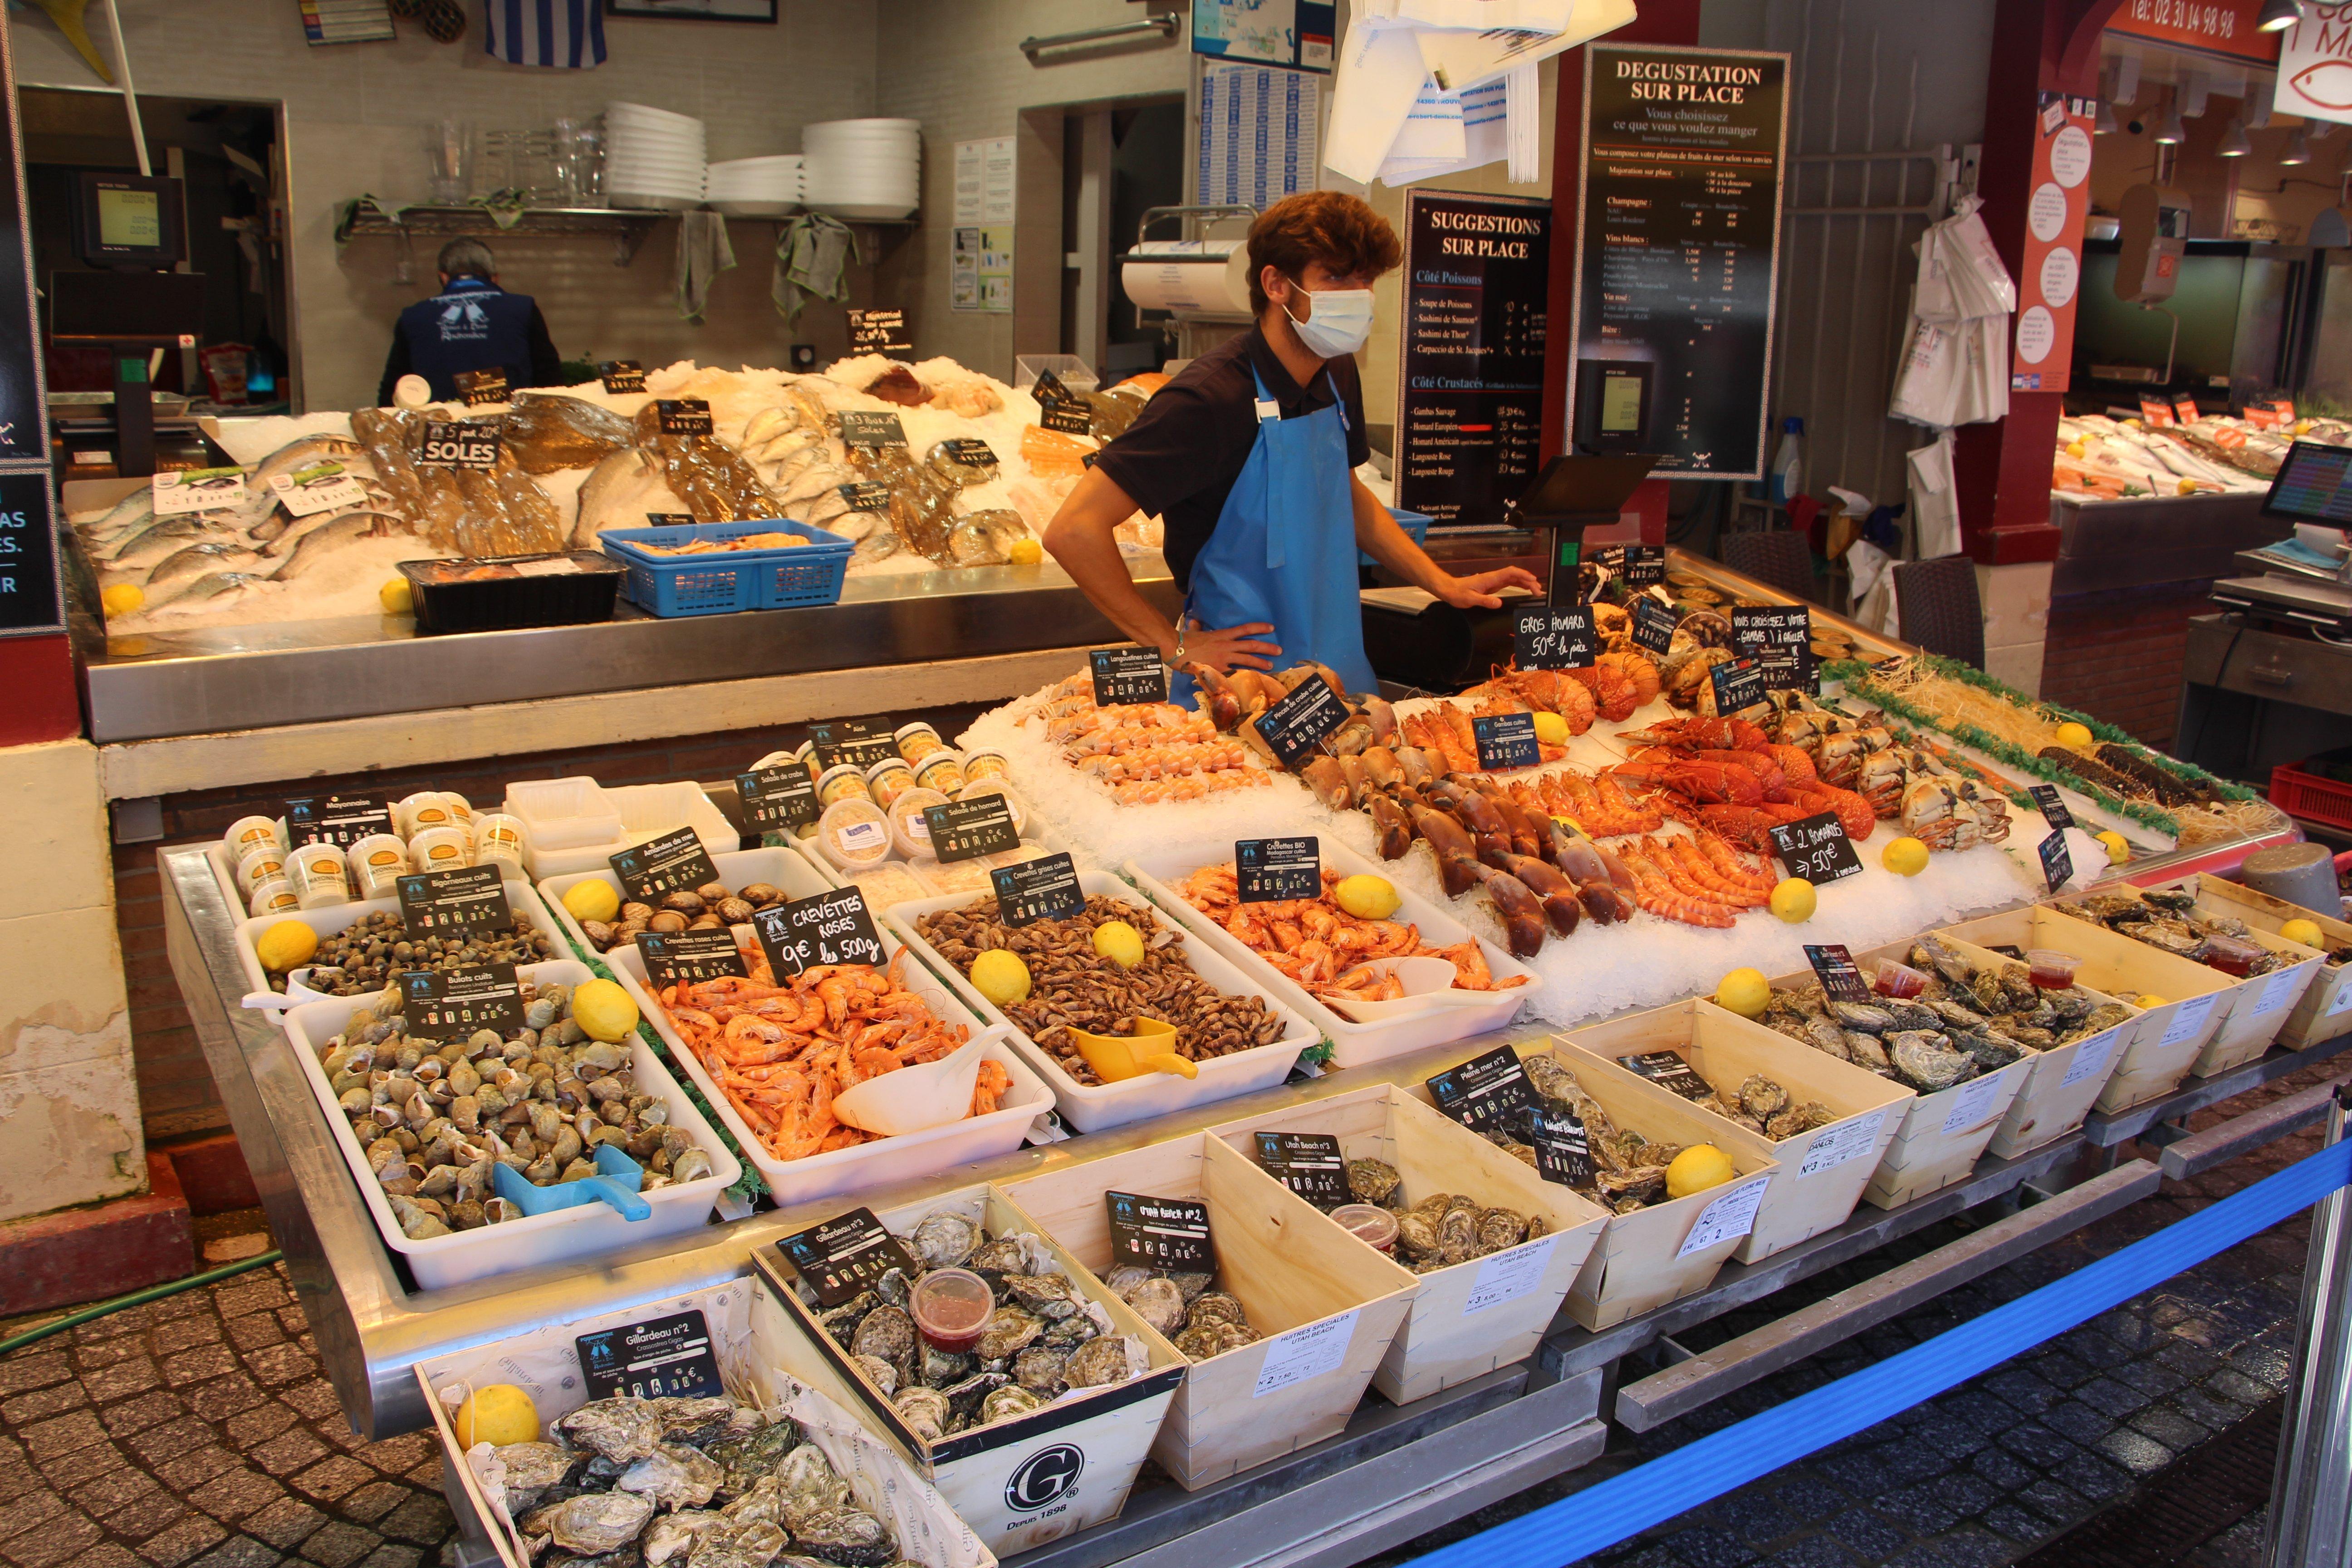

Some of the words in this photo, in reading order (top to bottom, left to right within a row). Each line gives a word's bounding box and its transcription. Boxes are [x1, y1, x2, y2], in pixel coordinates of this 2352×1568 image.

[2155, 0, 2170, 25] 02
[2173, 2, 2184, 28] 31
[2187, 5, 2199, 31] 14
[2203, 6, 2217, 35] 98
[2220, 9, 2234, 39] 98
[1617, 61, 1761, 85] DEGUSTATION
[1631, 82, 1671, 100] SUR
[1677, 85, 1744, 104] PLACE
[1646, 108, 1671, 119] Vous
[1675, 109, 1728, 122] choisissez
[1613, 120, 1626, 129] ce
[1629, 121, 1648, 132] que
[1651, 123, 1676, 132] vous
[1680, 123, 1714, 134] voulez
[1718, 126, 1758, 138] manger
[1594, 147, 1608, 156] Vous
[1609, 149, 1639, 158] composez
[1656, 151, 1677, 161] plateau
[1688, 152, 1703, 161] fruits
[1609, 166, 1643, 175] Majoration
[1656, 168, 1672, 176] place
[1607, 196, 1647, 206] Champagne
[1431, 211, 1541, 235] SUGGESTIONS
[1623, 235, 1644, 243] blancs
[1442, 237, 1474, 255] SUR
[1478, 240, 1528, 259] PLACE
[1416, 270, 1439, 283] Côté
[1442, 272, 1481, 284] Poissons
[1419, 298, 1437, 309] Soupe
[1448, 300, 1472, 309] Poissons
[1412, 376, 1435, 388] Côté
[1437, 377, 1483, 389] Crustacés
[1414, 407, 1434, 416] Gambas
[1436, 408, 1456, 417] Sauvage
[1413, 422, 1433, 431] Homard
[1435, 422, 1458, 432] Européen
[1413, 438, 1432, 446] Homard
[1434, 437, 1459, 446] Américain
[426, 441, 495, 462] SOLES
[1412, 453, 1437, 462] Langouste
[1412, 467, 1436, 477] Langouste
[1439, 467, 1454, 477] Rouge
[1521, 616, 1545, 633] GROS
[1552, 614, 1585, 631] HOMARD
[1734, 615, 1749, 627] VOUS
[1751, 614, 1786, 627] CHOISISSEZ
[1787, 614, 1807, 626] VOTRE
[1110, 653, 1142, 664] Langoustines
[1274, 706, 1290, 720] Pinces
[1295, 689, 1309, 703] crabe
[1308, 680, 1323, 692] cuites
[761, 775, 779, 784] Salade
[788, 770, 804, 779] crabe
[326, 799, 371, 810] Mayonnaise
[948, 807, 969, 816] Salade
[978, 799, 1001, 810] homard
[1797, 829, 1809, 849] 2
[1808, 821, 1843, 846] HOMARDS
[644, 841, 673, 857] Amandes
[681, 832, 695, 842] mer
[1267, 843, 1294, 851] Crevettes
[1013, 868, 1038, 880] Crevettes
[1038, 864, 1054, 876] grises
[1054, 861, 1070, 870] cuites
[431, 877, 473, 888] Bigorneaux
[474, 872, 491, 882] cuits
[792, 894, 862, 927] CREVETTES
[818, 916, 856, 939] ROSES
[665, 937, 694, 945] Crevettes
[818, 941, 838, 964] les
[840, 936, 880, 963] 500g
[447, 975, 472, 984] Bulots
[474, 972, 493, 981] cuits
[1460, 1068, 1481, 1081] Pleine
[1481, 1062, 1493, 1071] mer
[1494, 1055, 1506, 1066] n°2
[1284, 1141, 1301, 1149] Utah
[1301, 1141, 1319, 1149] Beach
[1320, 1142, 1331, 1150] n°3
[1808, 1138, 1835, 1152] DANLOS
[1139, 1205, 1159, 1218] UTAH
[816, 1225, 851, 1243] Gillardeau
[850, 1218, 865, 1229] n°3
[1715, 1228, 1722, 1240] 2
[626, 1327, 672, 1346] Gillardeau
[673, 1322, 690, 1335] n°2
[1280, 1329, 1311, 1343] HUITRES
[1312, 1313, 1350, 1332] SPECIALES
[1291, 1334, 1310, 1345] UTAH
[1311, 1325, 1335, 1338] BEACH
[1266, 1376, 1274, 1385] 2
[1018, 1450, 1076, 1503] G
[1041, 1504, 1067, 1519] 1898
